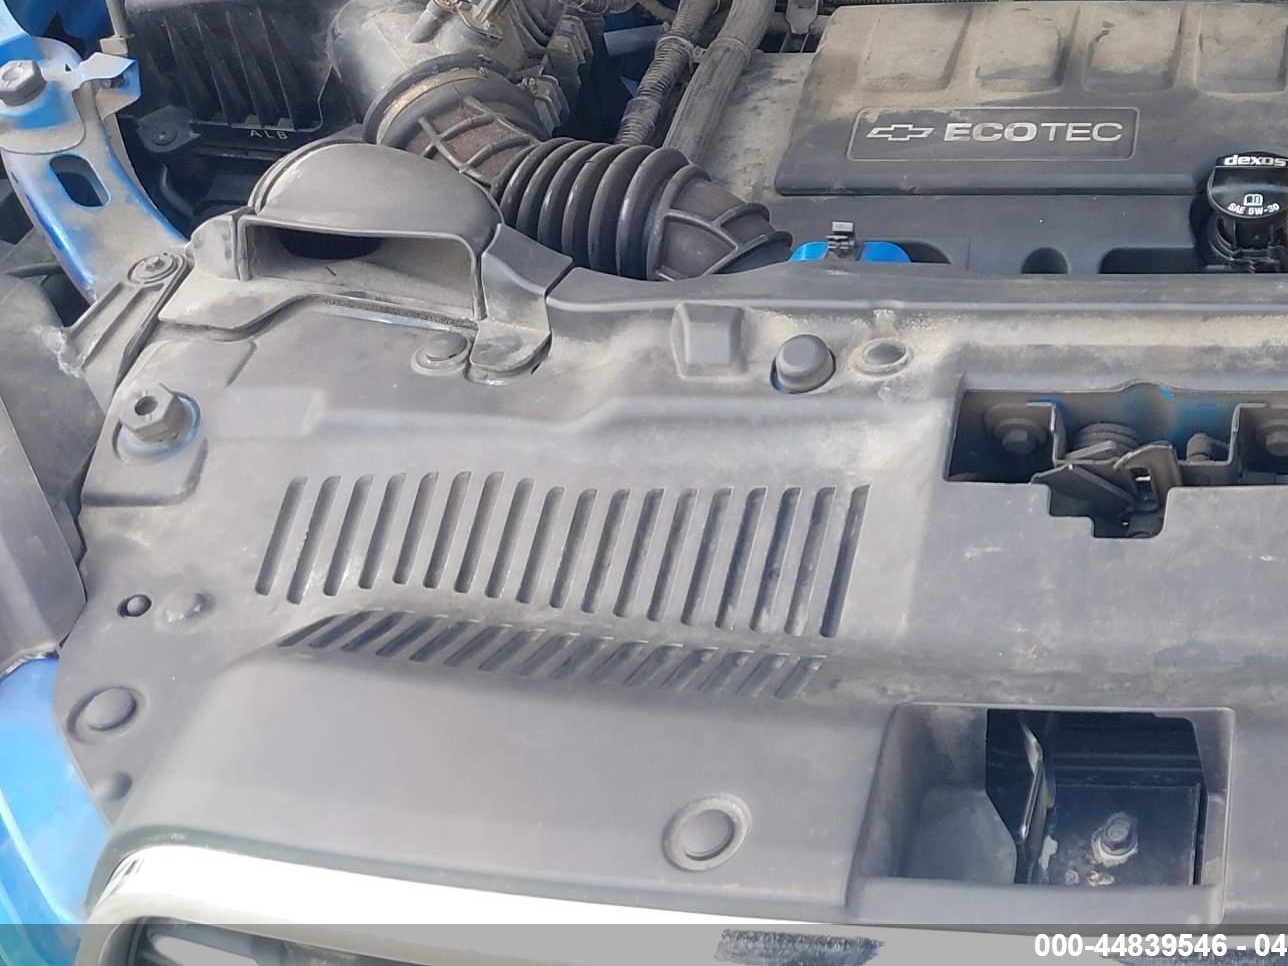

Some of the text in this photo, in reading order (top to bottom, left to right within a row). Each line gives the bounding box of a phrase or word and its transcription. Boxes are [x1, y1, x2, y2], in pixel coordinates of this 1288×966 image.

[943, 122, 1124, 142] ECOTEC
[1227, 202, 1280, 216] SAE 5W-30
